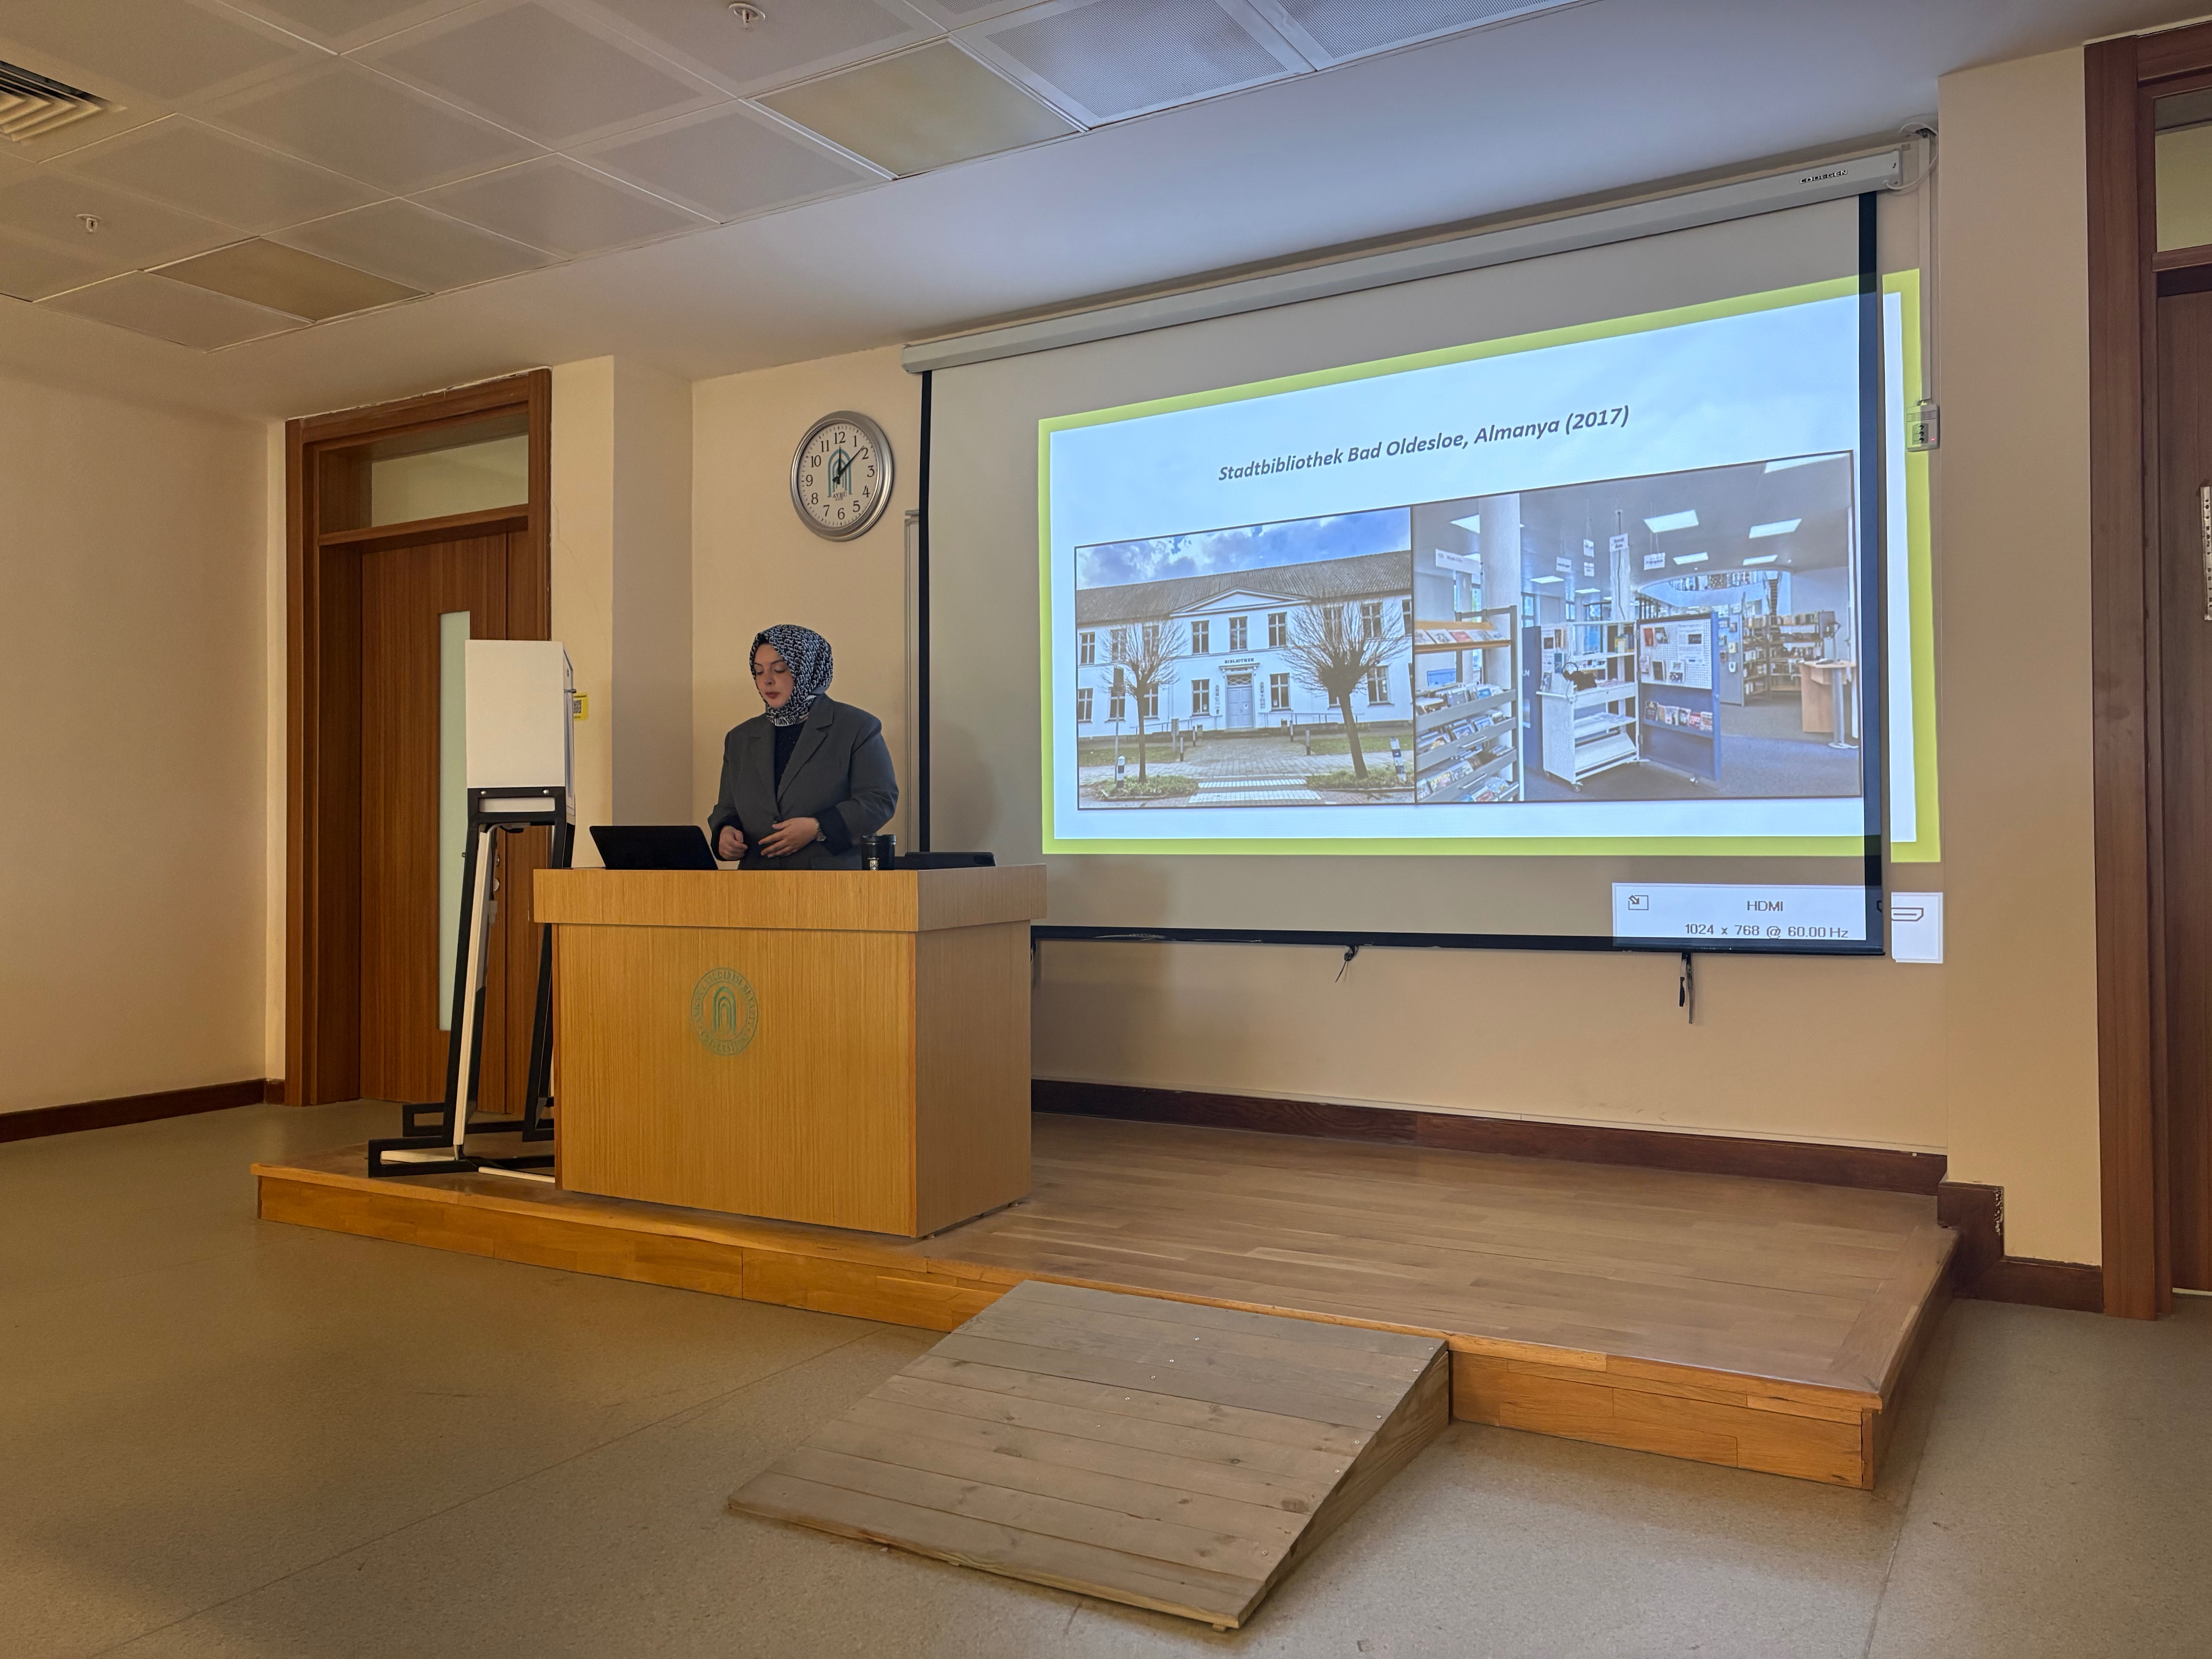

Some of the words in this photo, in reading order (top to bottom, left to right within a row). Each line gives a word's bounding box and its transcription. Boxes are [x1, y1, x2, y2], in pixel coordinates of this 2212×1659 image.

[1800, 170, 1847, 184] CODEGEN
[835, 431, 846, 445] 12
[854, 435, 857, 447] 1
[1218, 448, 1343, 481] Stadtbibliothek
[1348, 441, 1382, 462] Bad
[1386, 432, 1468, 456] Oldesloe,
[1474, 420, 1560, 444] Almanya
[1566, 405, 1629, 435] (2017)
[821, 440, 830, 452] 11
[862, 447, 869, 460] 2
[811, 455, 822, 467] 10
[867, 465, 875, 477] 3
[806, 474, 813, 486] 9
[862, 485, 871, 498] 4
[811, 493, 819, 505] 8
[823, 504, 830, 517] 7
[853, 500, 860, 512] 5
[838, 507, 845, 520] 6
[1747, 900, 1783, 912] HDMI
[1685, 924, 1714, 934] 1024
[1735, 925, 1760, 936] 768
[1766, 926, 1781, 938] @
[1788, 926, 1826, 938] 60.00
[1829, 927, 1848, 938] Hz
